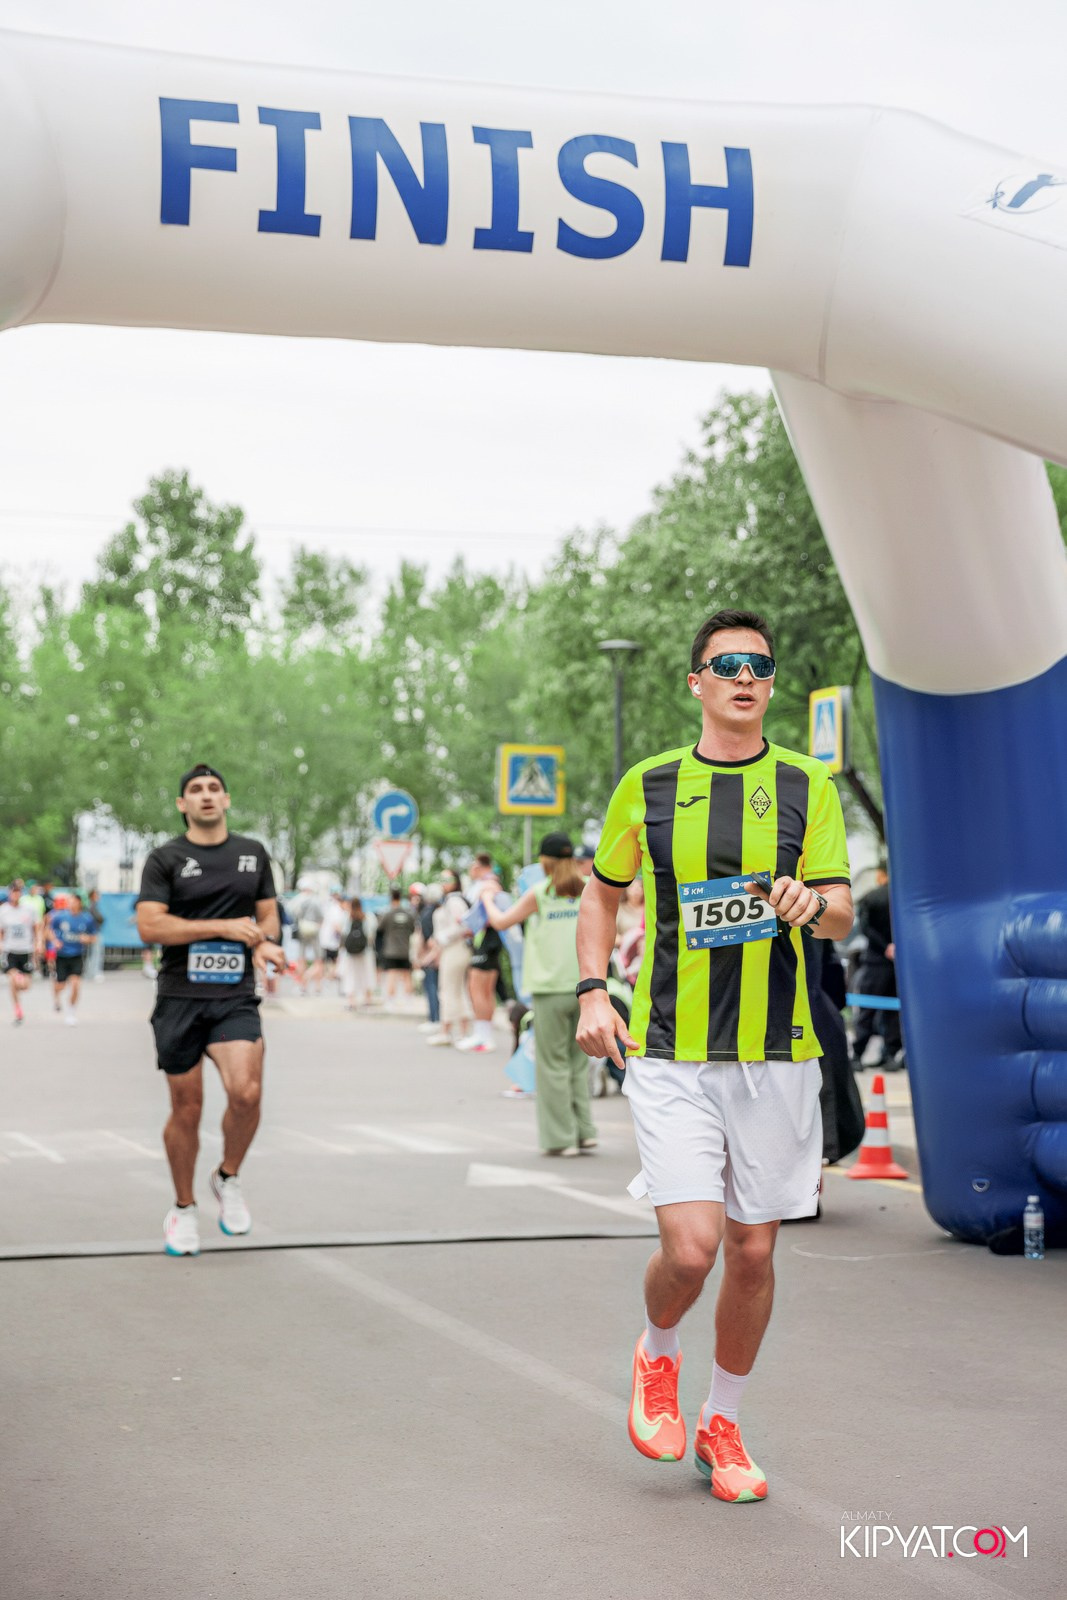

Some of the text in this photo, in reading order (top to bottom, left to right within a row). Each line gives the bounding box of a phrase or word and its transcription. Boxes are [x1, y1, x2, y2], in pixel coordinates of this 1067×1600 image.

[158, 97, 755, 268] FINISH
[683, 887, 704, 896] 5 KM
[693, 896, 764, 928] 1505
[195, 956, 239, 969] 1090
